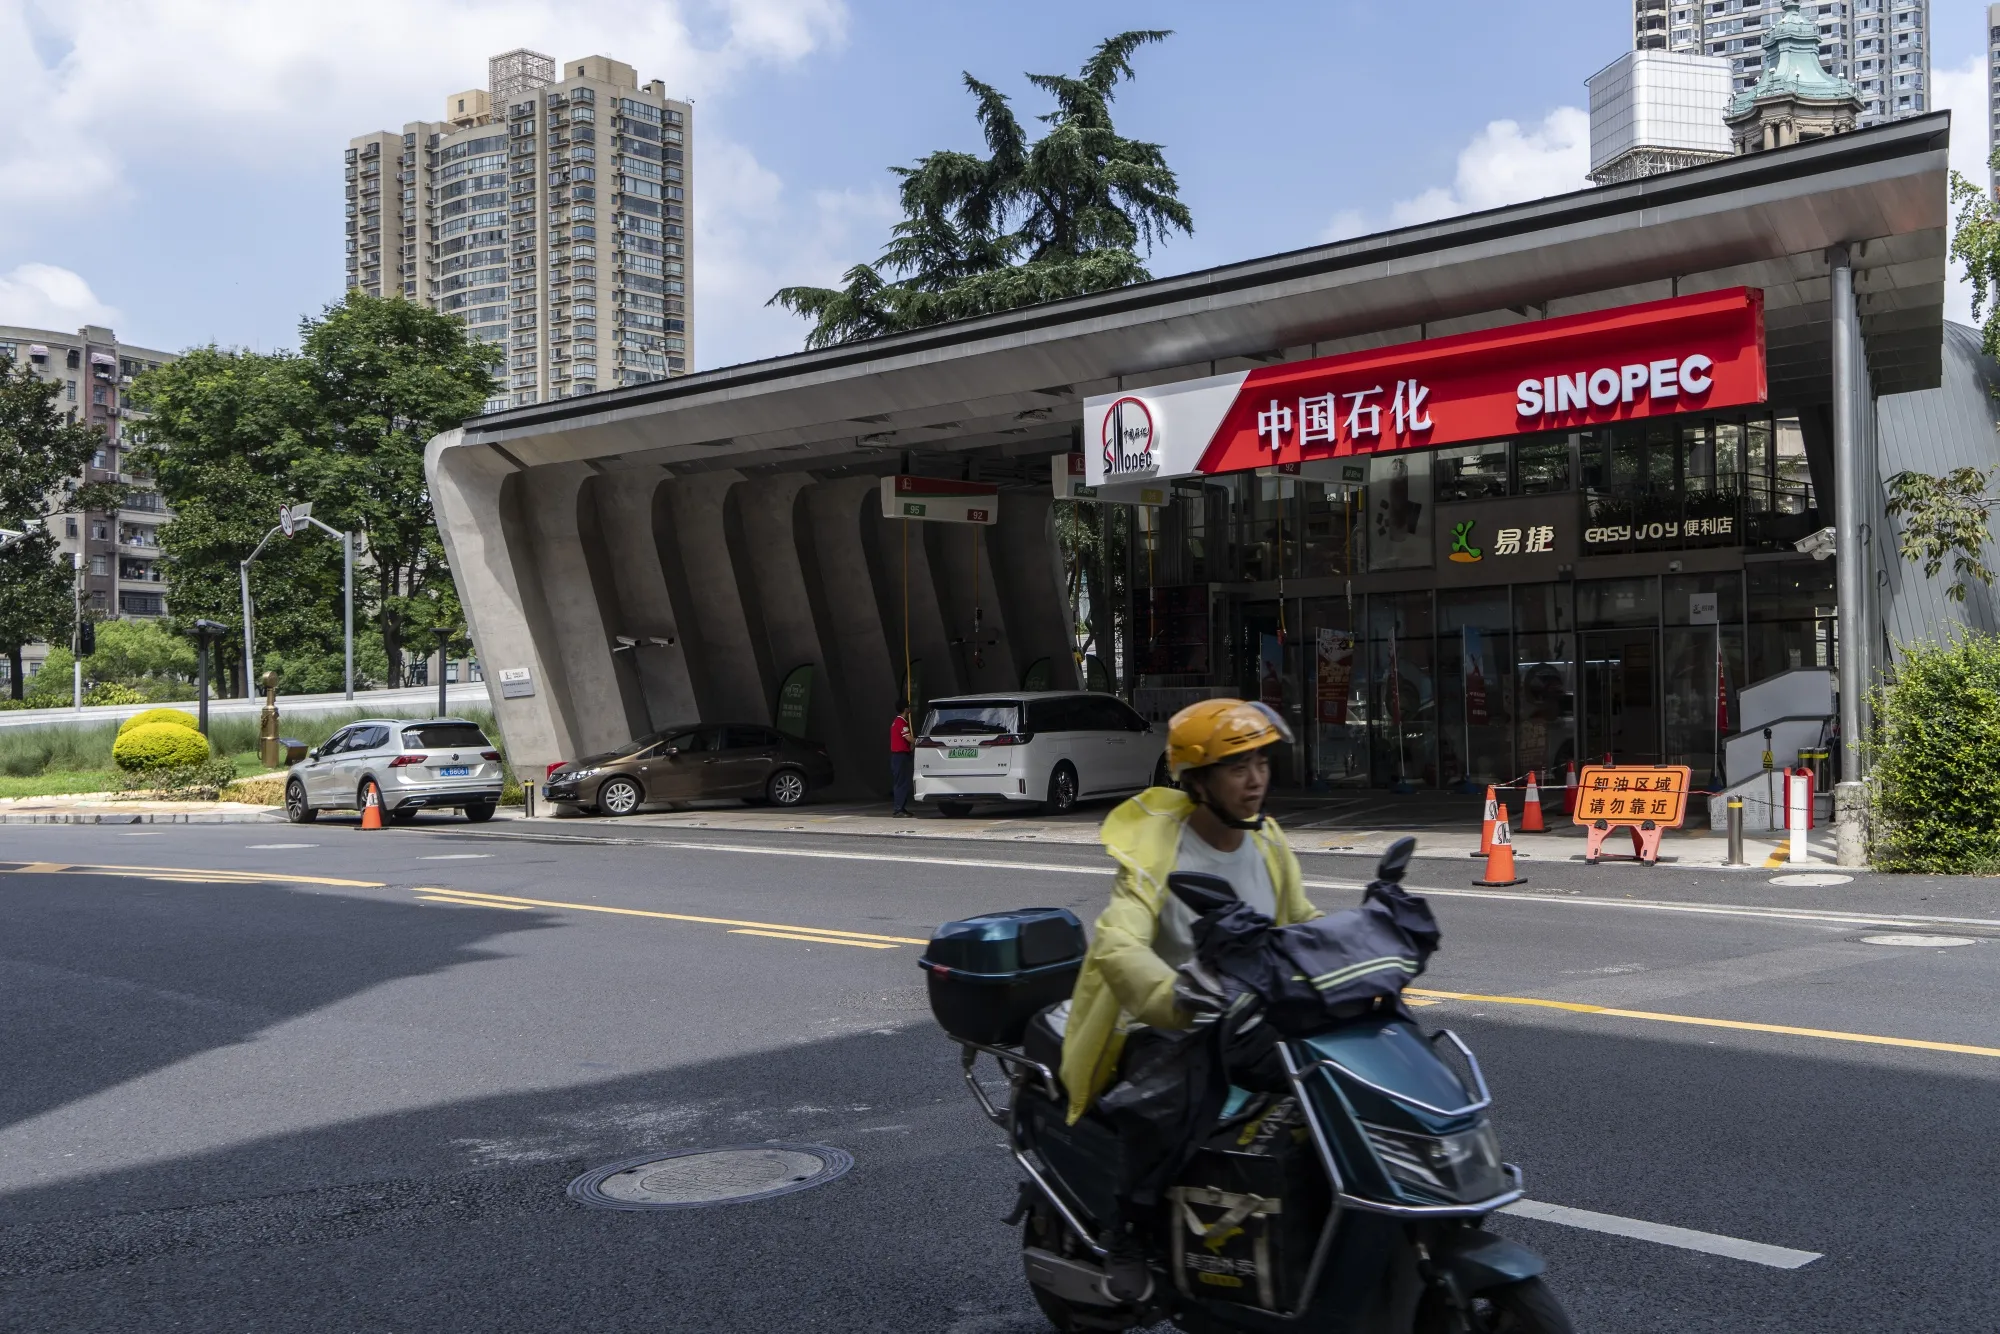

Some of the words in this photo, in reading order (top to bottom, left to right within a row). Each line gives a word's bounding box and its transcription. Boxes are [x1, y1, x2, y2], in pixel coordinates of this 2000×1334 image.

[1516, 353, 1714, 417] SINOPEC
[1256, 378, 1433, 450] 中国石化
[909, 505, 920, 515] 95
[972, 511, 983, 520] 92
[1494, 524, 1555, 556] 易捷
[1584, 525, 1631, 543] EASY
[1634, 522, 1679, 540] JOY
[1683, 516, 1734, 538] 便利店
[1593, 776, 1672, 792] 卸油区域
[1589, 798, 1667, 814] 请勿靠近
